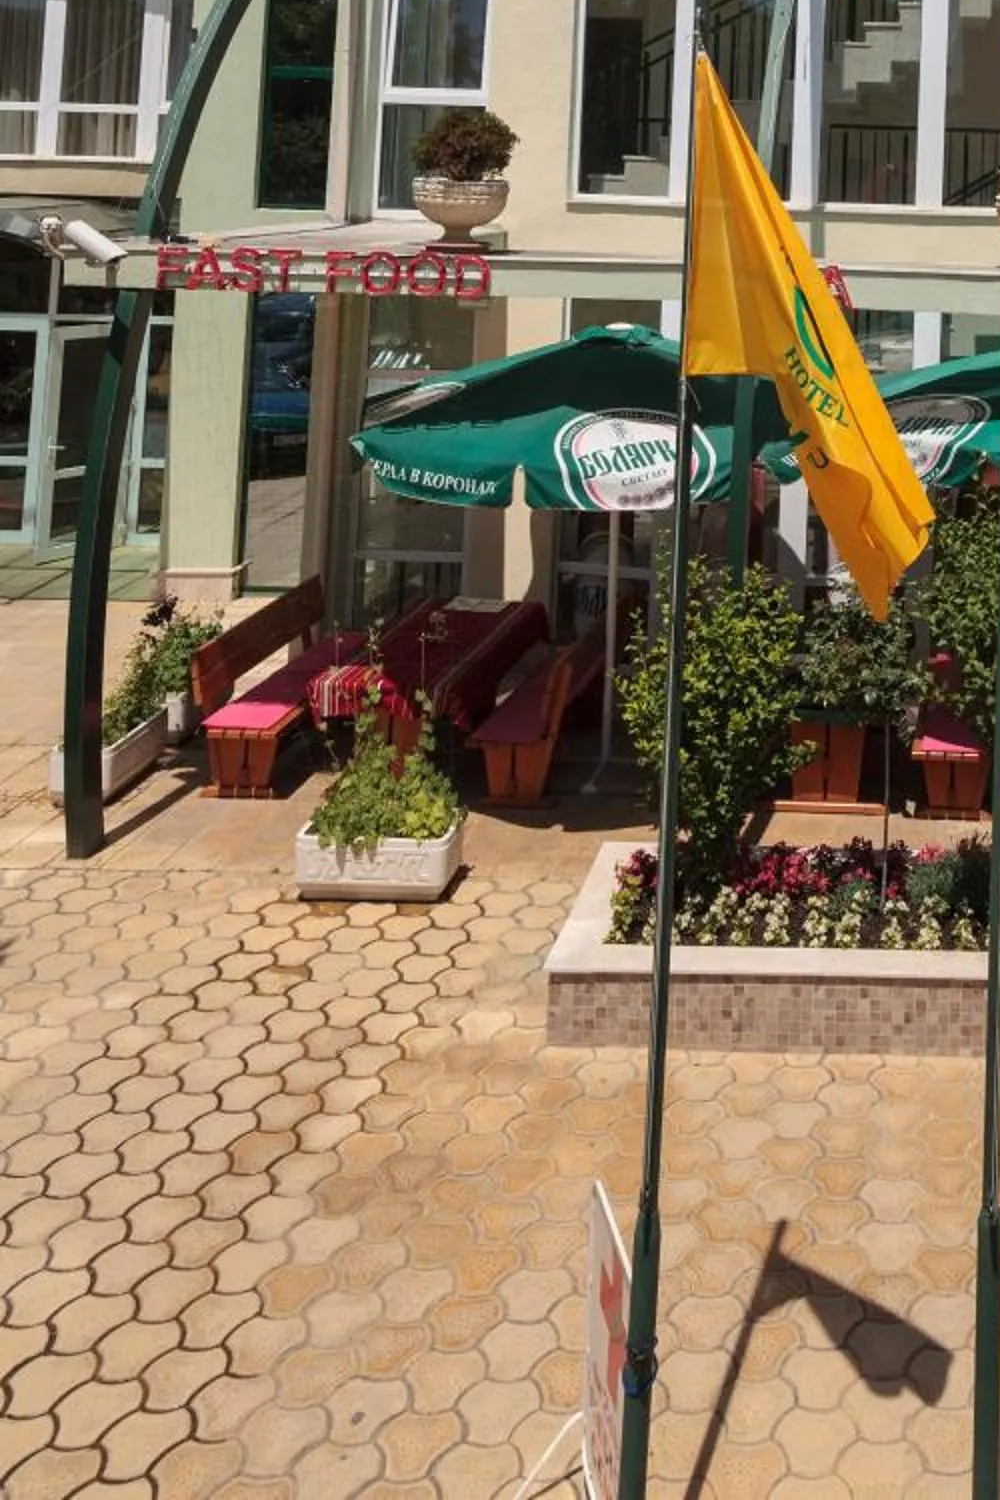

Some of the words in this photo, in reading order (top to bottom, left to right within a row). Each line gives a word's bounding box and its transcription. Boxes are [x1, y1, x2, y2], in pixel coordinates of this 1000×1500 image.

[156, 246, 302, 292] FAST
[325, 251, 491, 299] FOOD
[784, 344, 849, 428] HOTEL
[369, 457, 407, 481] ЕРЛА
[577, 439, 676, 480] БОЛЯРК
